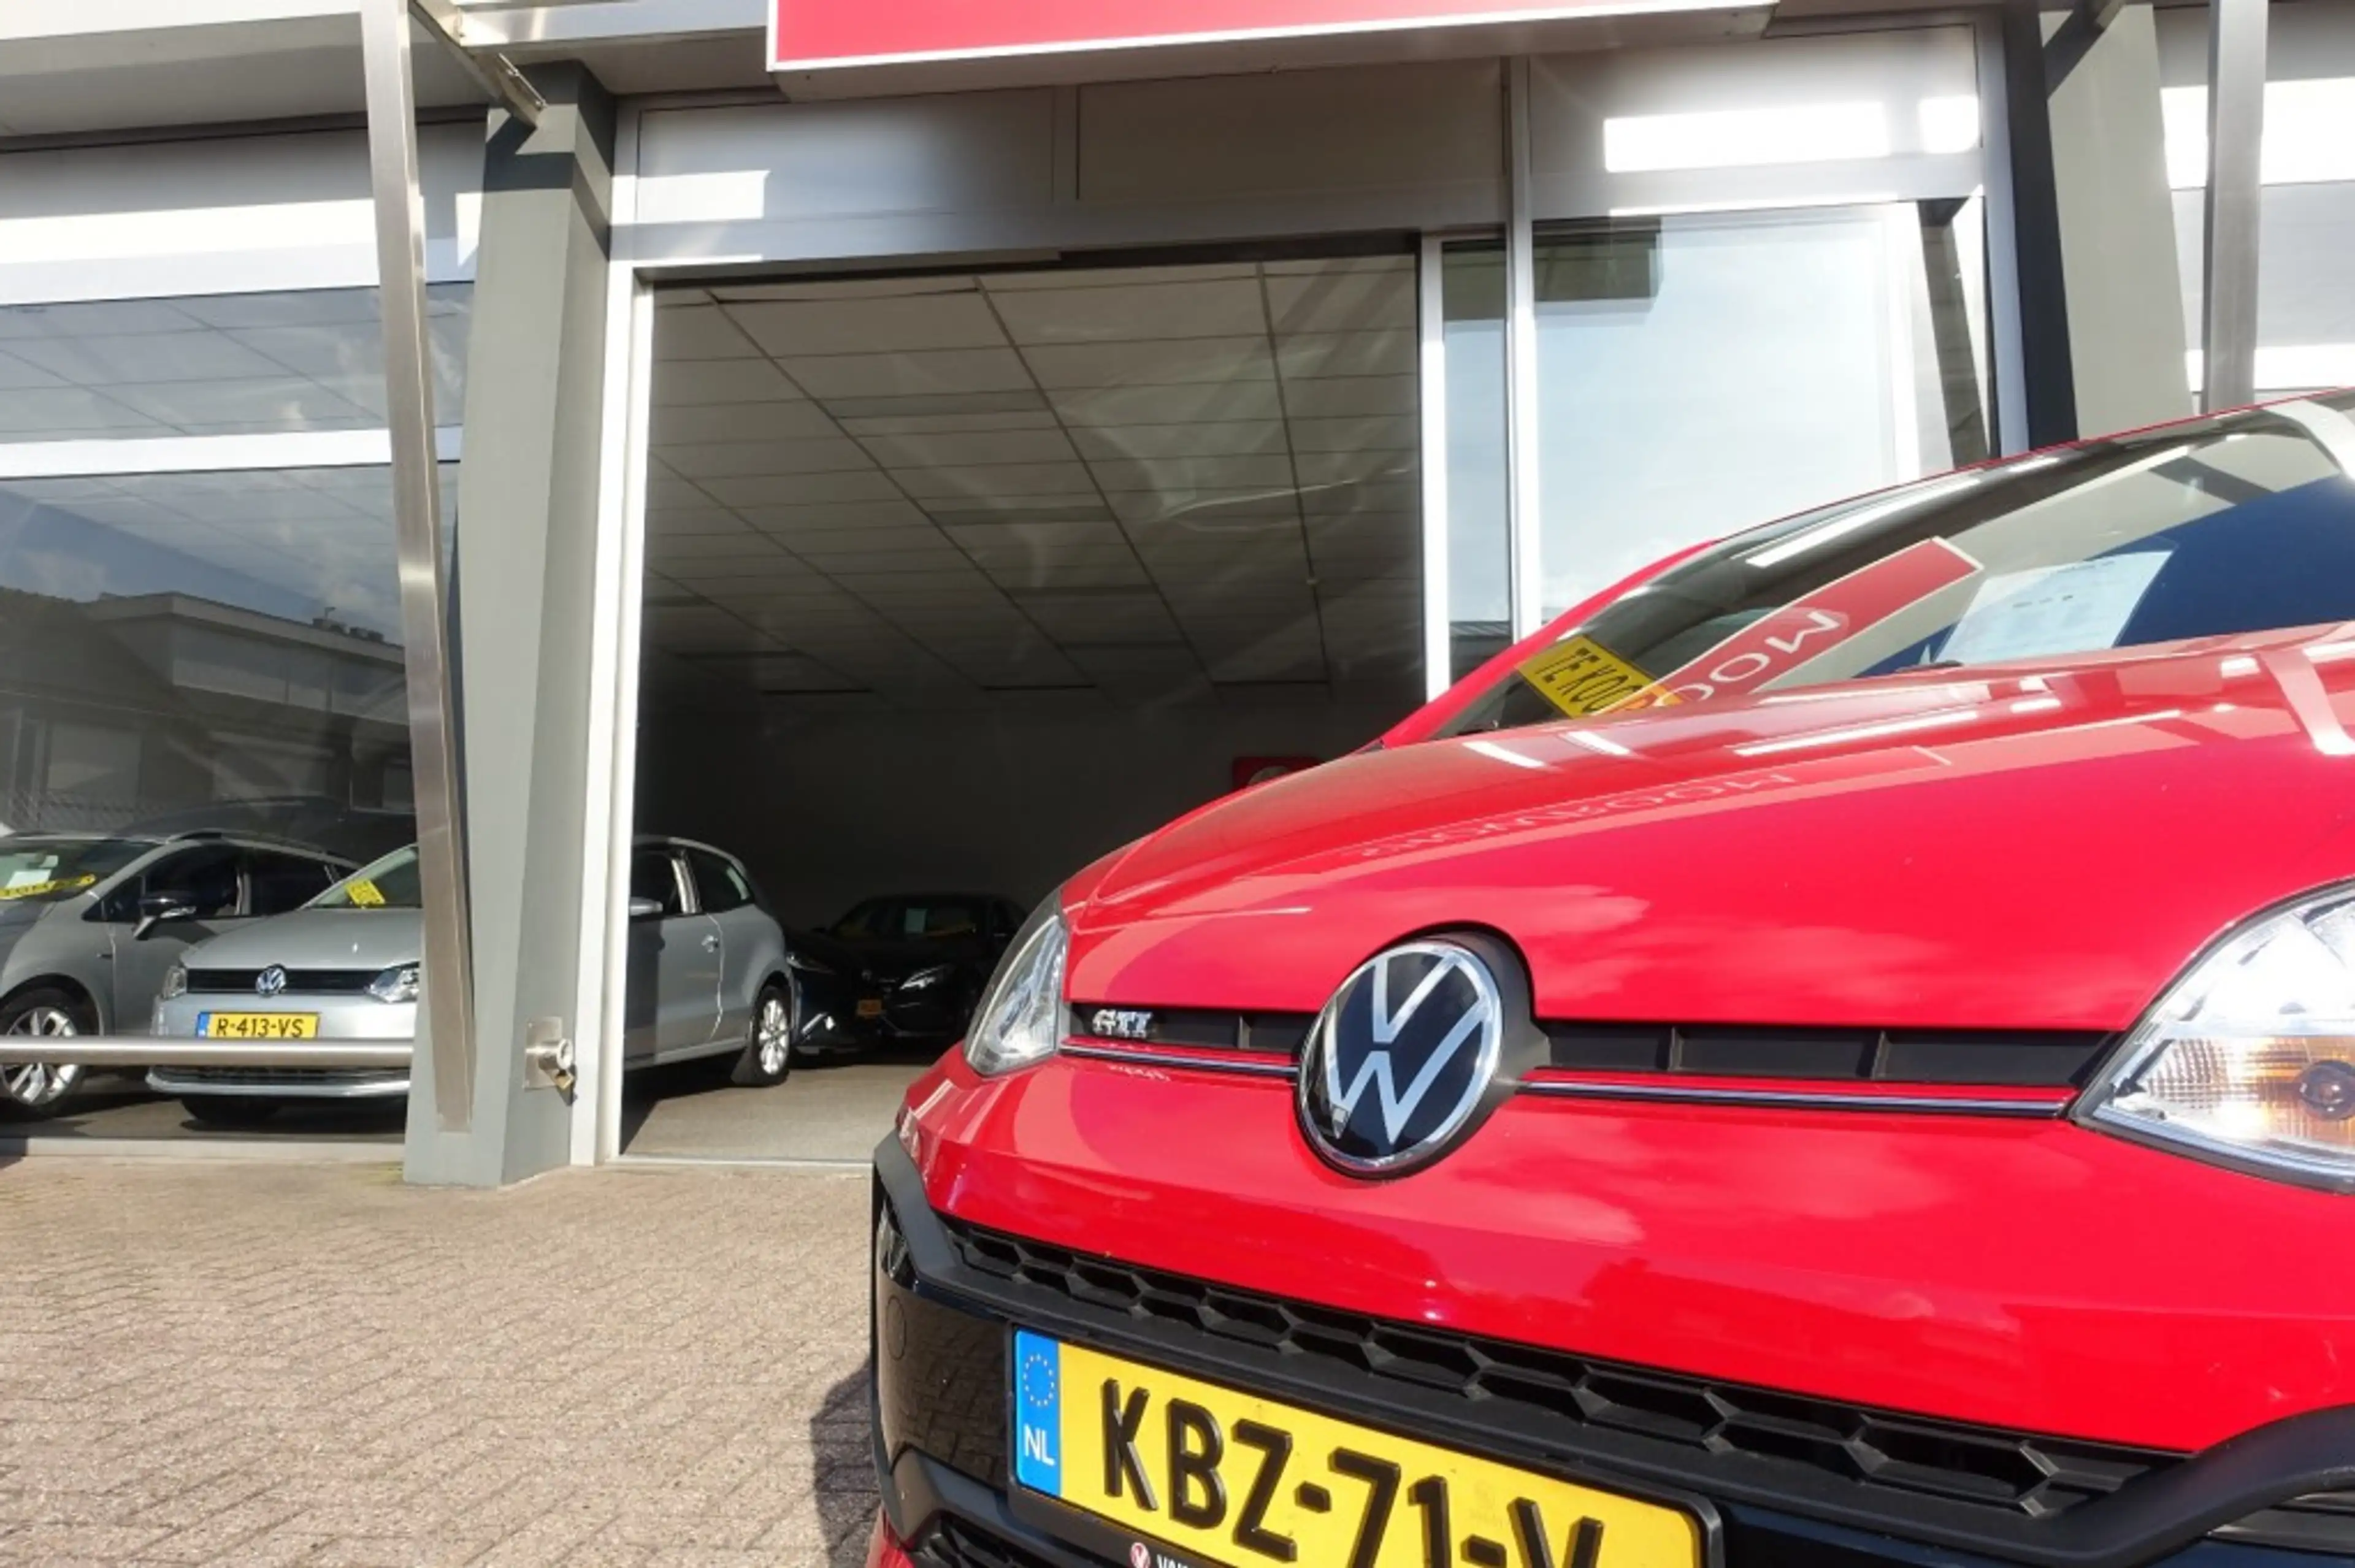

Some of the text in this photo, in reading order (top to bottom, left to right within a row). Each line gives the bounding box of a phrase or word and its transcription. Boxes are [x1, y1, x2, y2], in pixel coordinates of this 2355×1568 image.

[1534, 646, 1601, 684] TE
[216, 1017, 304, 1038] R-413-VS
[1092, 1009, 1152, 1038] GTI
[1023, 1424, 1055, 1466] NL
